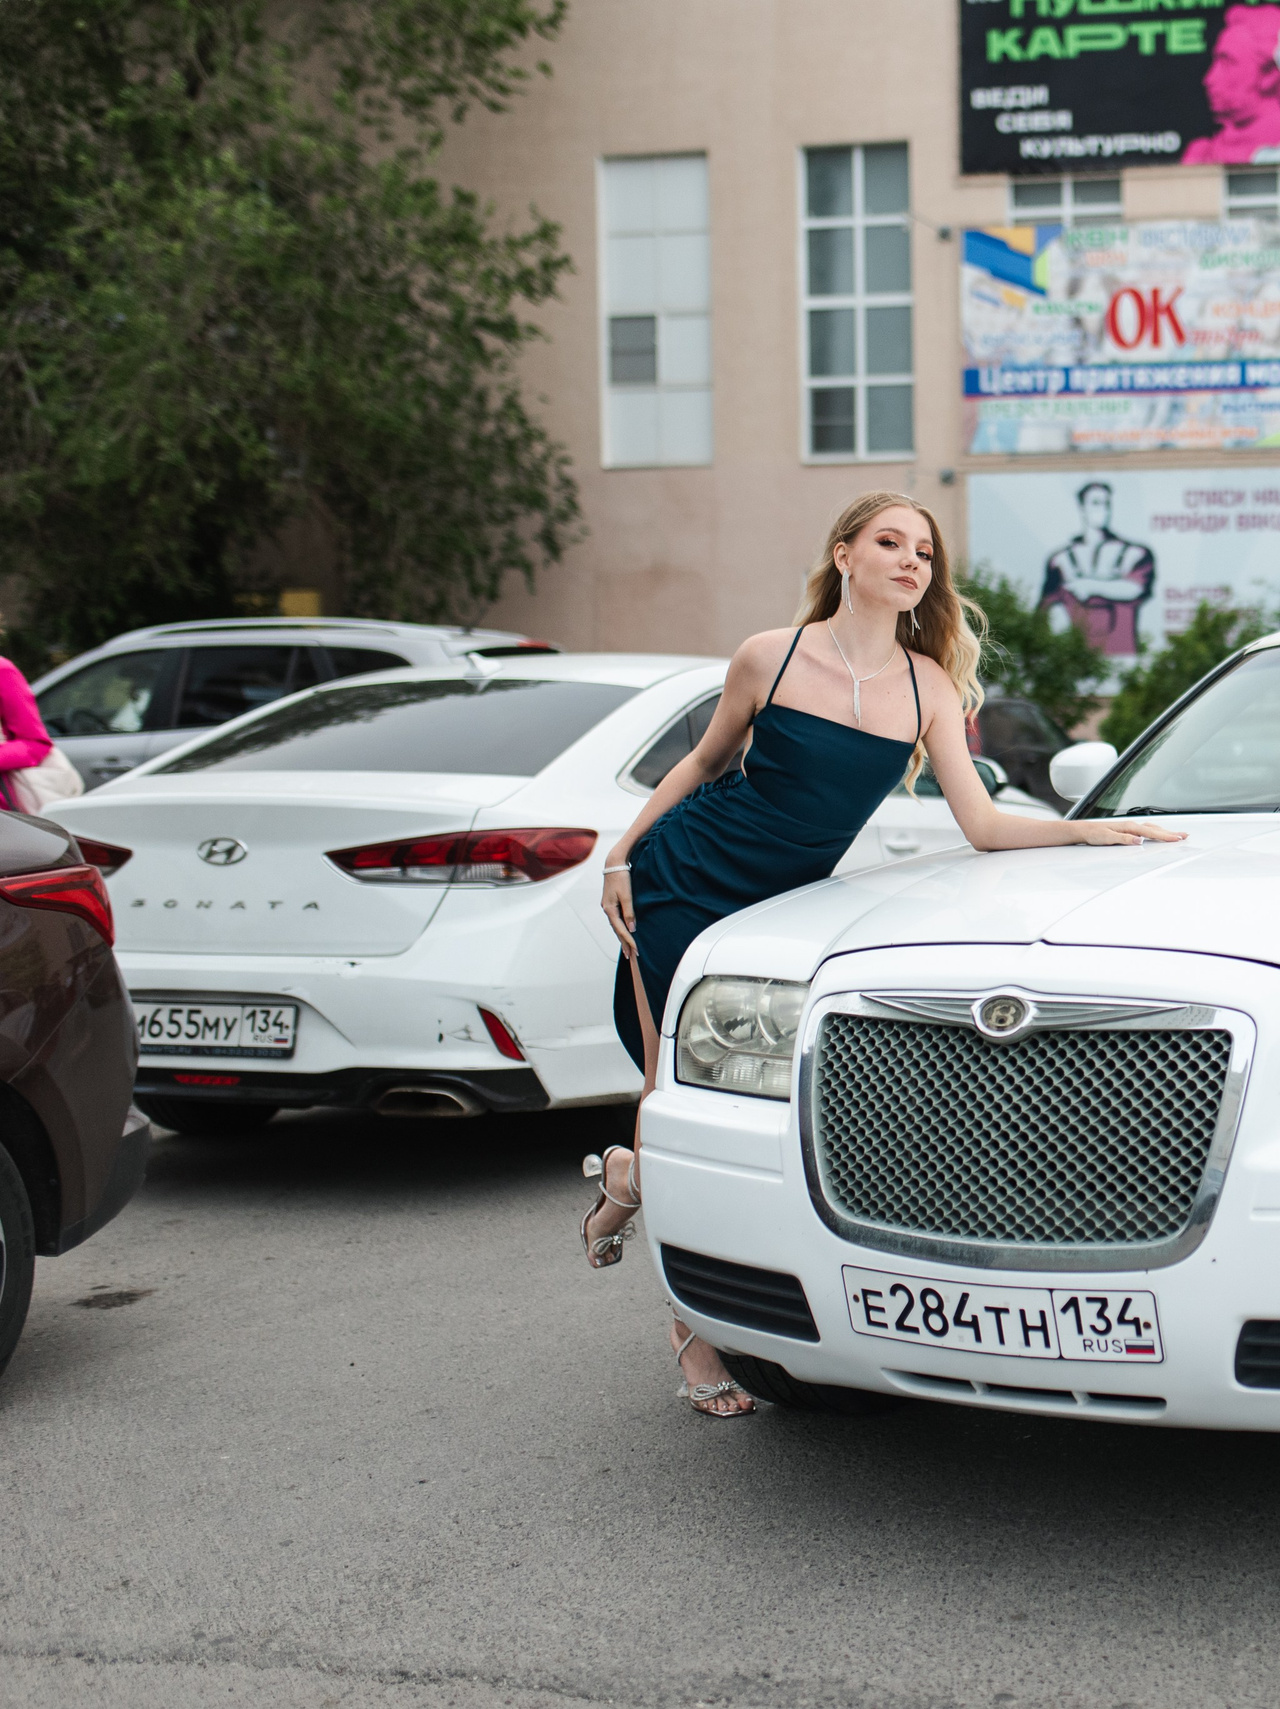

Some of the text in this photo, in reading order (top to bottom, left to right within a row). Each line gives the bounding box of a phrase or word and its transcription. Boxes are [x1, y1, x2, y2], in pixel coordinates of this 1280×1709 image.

[985, 18, 1208, 63] КАРТЕ
[971, 85, 1050, 110] ВЕДИ
[995, 109, 1074, 134] СЕБЯ
[1020, 131, 1182, 159] КУЛЬТУРНО
[978, 367, 1066, 394] Центр
[1069, 362, 1242, 392] притяжения
[1184, 488, 1246, 507] СПАСИ
[1150, 511, 1230, 533] ПРОЙДИ
[130, 898, 320, 910] SONATA
[245, 1009, 284, 1034] 134
[252, 1034, 273, 1044] RUS
[861, 1283, 1142, 1348] Е284ТН 134
[1083, 1338, 1123, 1353] RUS
